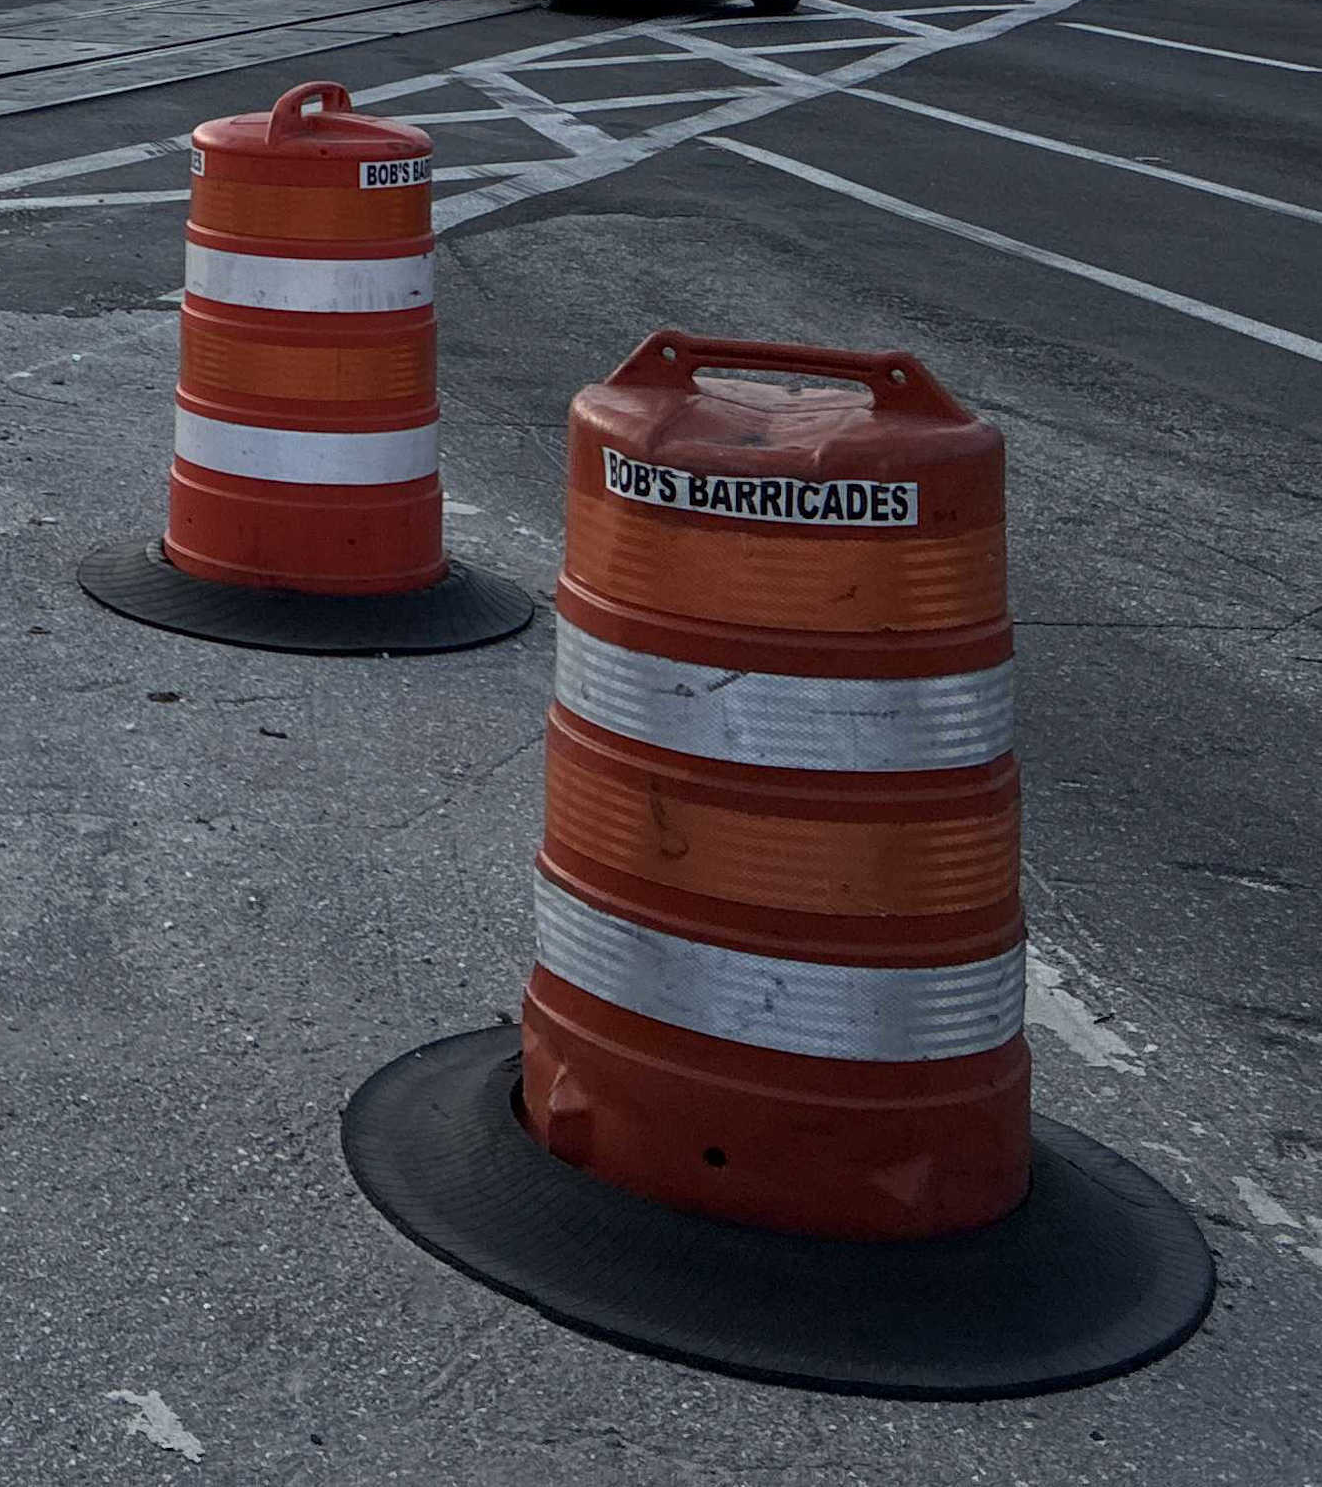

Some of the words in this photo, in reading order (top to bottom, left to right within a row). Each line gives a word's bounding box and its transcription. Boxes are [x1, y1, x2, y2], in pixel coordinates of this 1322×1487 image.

[367, 162, 410, 186] BOB'S
[609, 452, 677, 502] BOB'S
[688, 476, 909, 522] BARRICADES
